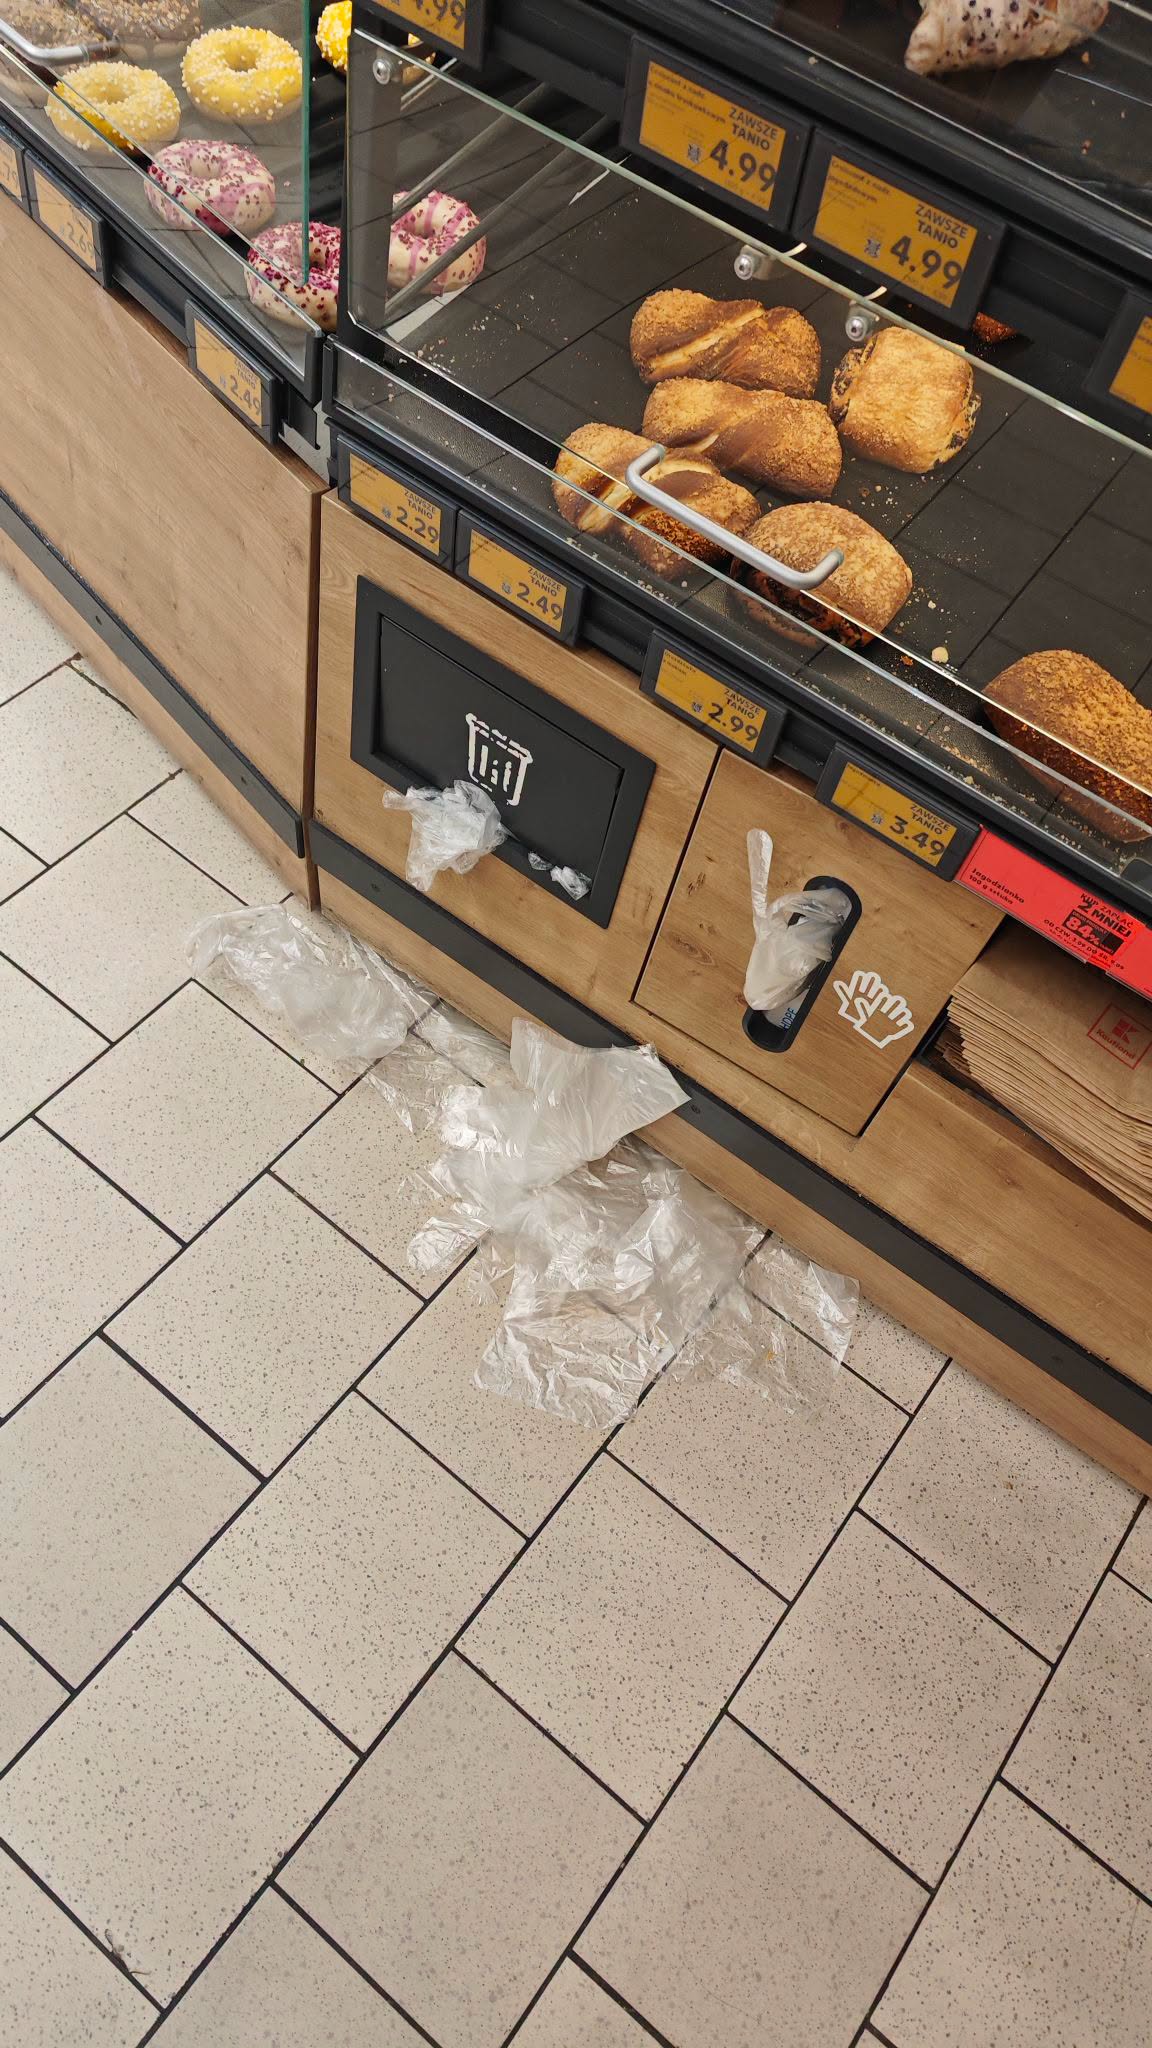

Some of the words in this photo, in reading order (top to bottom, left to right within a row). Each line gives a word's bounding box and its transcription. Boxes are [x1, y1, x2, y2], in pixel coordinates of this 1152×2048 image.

[728, 107, 779, 140] ZAWSZE
[732, 123, 770, 151] TANIO
[710, 139, 776, 192] 4.99
[915, 203, 969, 239] ZAWSZE
[917, 219, 958, 249] TANIO
[890, 235, 962, 289] 4.99
[229, 374, 261, 416] 2.49
[404, 489, 436, 514] ZAWSZE
[408, 499, 433, 520] TANIO
[396, 505, 439, 544] 2.29
[527, 566, 561, 591] ZAWSZE
[530, 575, 557, 597] TANIO
[516, 582, 563, 620] 2.49
[723, 688, 761, 715] ZAWSZE
[726, 698, 755, 720] TANIO
[708, 702, 759, 741] 2.99
[910, 803, 951, 832] ZAWSZE
[911, 812, 943, 835] TANIO
[889, 815, 945, 856] 3.49
[969, 874, 982, 885] 100
[971, 868, 1025, 904] Jagodzianka
[1065, 916, 1100, 946] 84%
[1077, 899, 1093, 914] 2
[1091, 908, 1132, 938] MNIEJ
[1043, 919, 1055, 928] OD
[1086, 946, 1098, 955] DO
[1096, 1028, 1136, 1059] Kaufland
